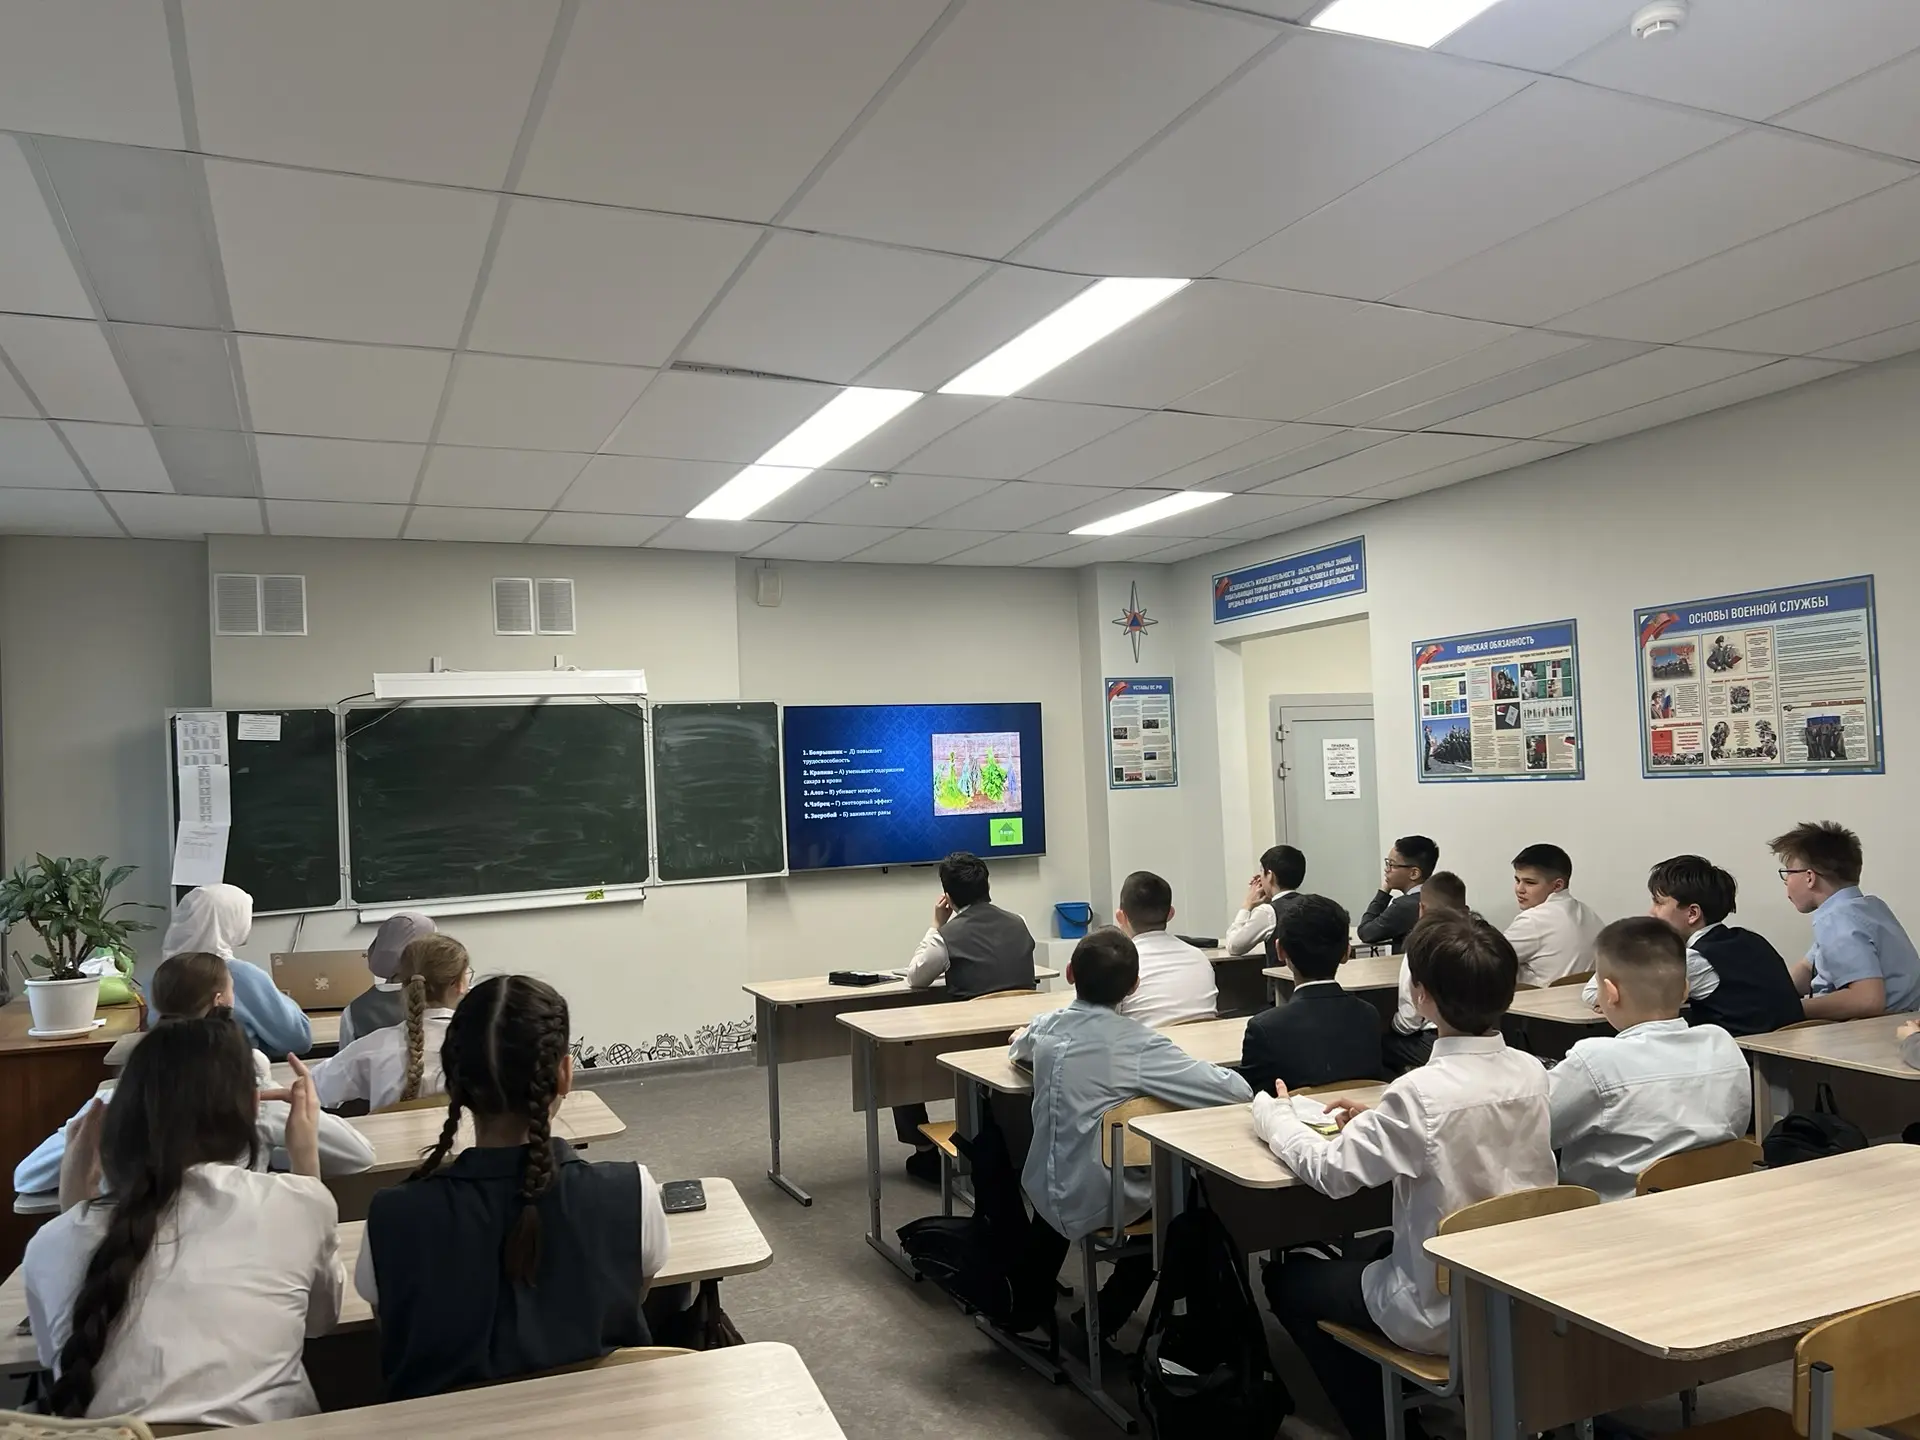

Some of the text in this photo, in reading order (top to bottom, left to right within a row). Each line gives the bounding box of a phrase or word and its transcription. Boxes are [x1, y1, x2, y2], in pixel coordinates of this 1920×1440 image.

[1229, 580, 1255, 591] БЕЗОПАСНОСТЬ
[1315, 560, 1335, 570] НАУЧНЫХ
[1309, 571, 1328, 580] ЧЕЛОВЕКА
[1688, 595, 1829, 625] ОСНОВЫ ВОЕННОЙ СЛУЖБЫ
[1457, 636, 1535, 654] ВОИНСКАЯ ОБЯЗАННОСТЬ
